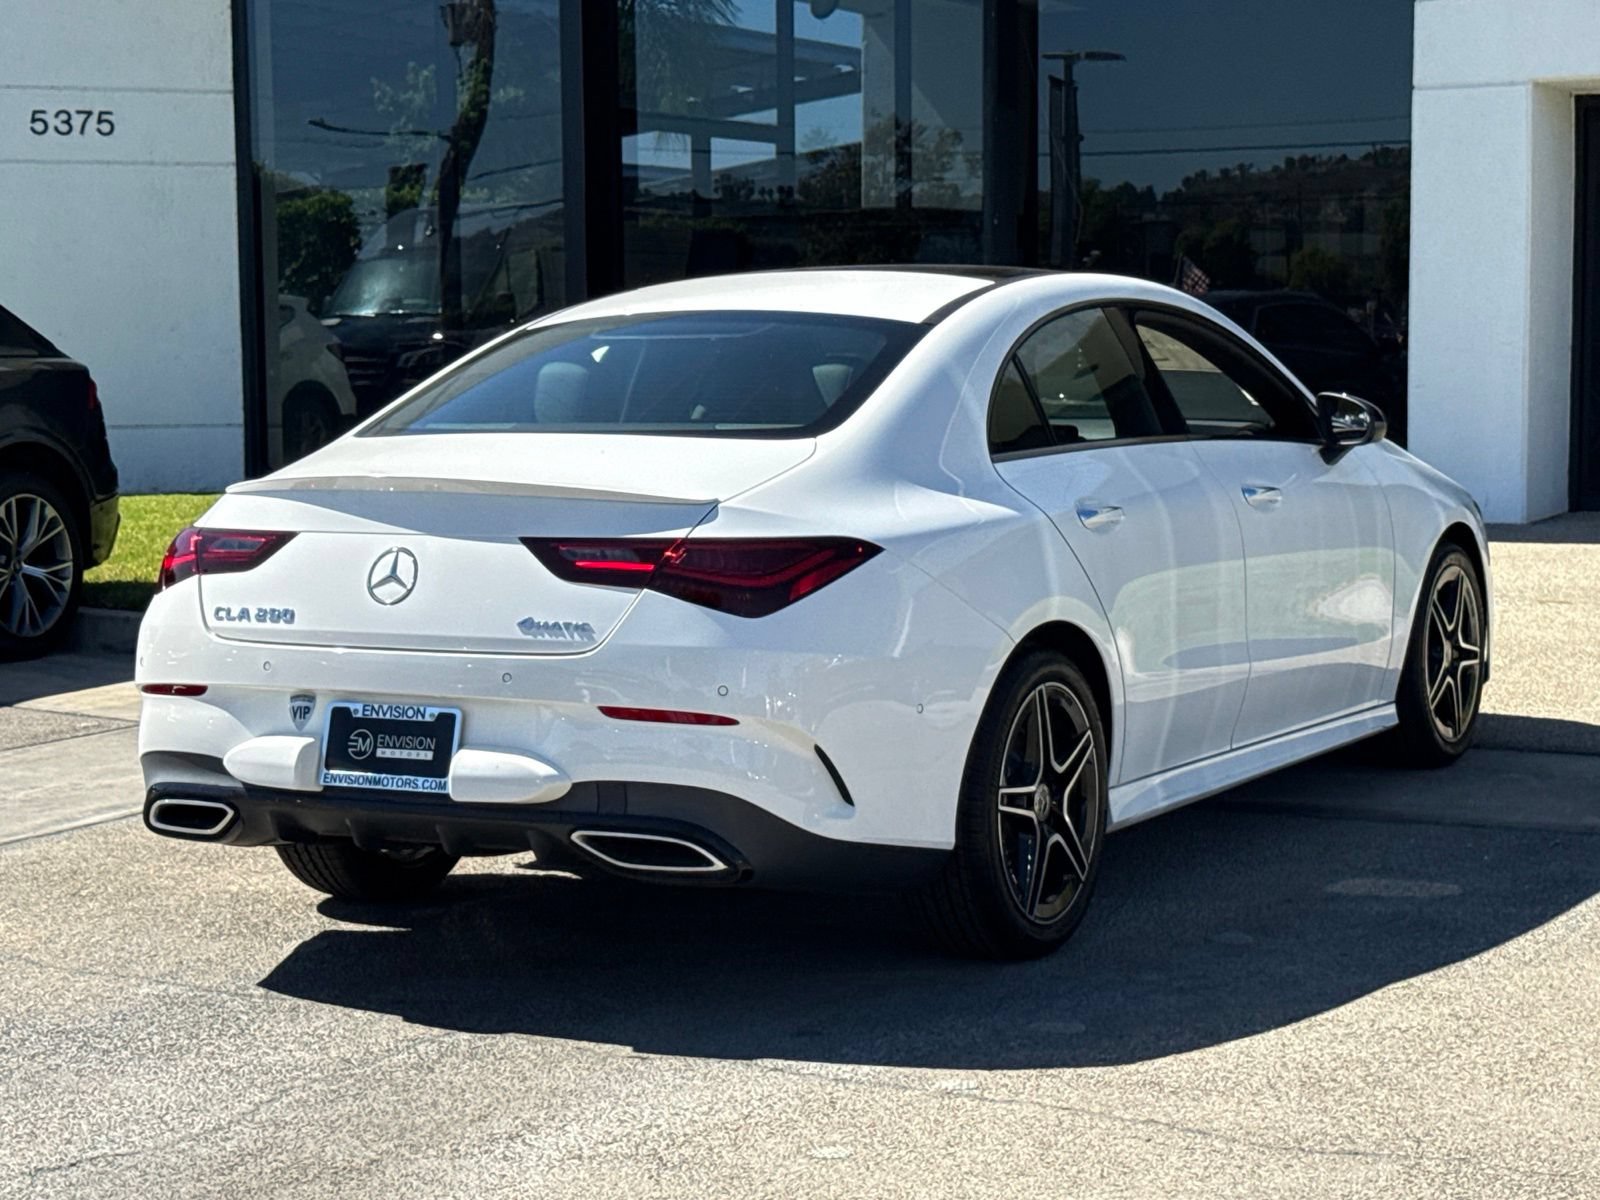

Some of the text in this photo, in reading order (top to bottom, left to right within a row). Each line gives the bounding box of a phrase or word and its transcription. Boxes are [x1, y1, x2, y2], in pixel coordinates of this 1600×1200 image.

[29, 109, 115, 136] 5375
[214, 606, 251, 622] CLA
[292, 705, 311, 720] VIP
[362, 704, 426, 719] ENVISION
[377, 734, 436, 750] ENVISION
[323, 773, 447, 790] ENVISIONMOTORS.COM
